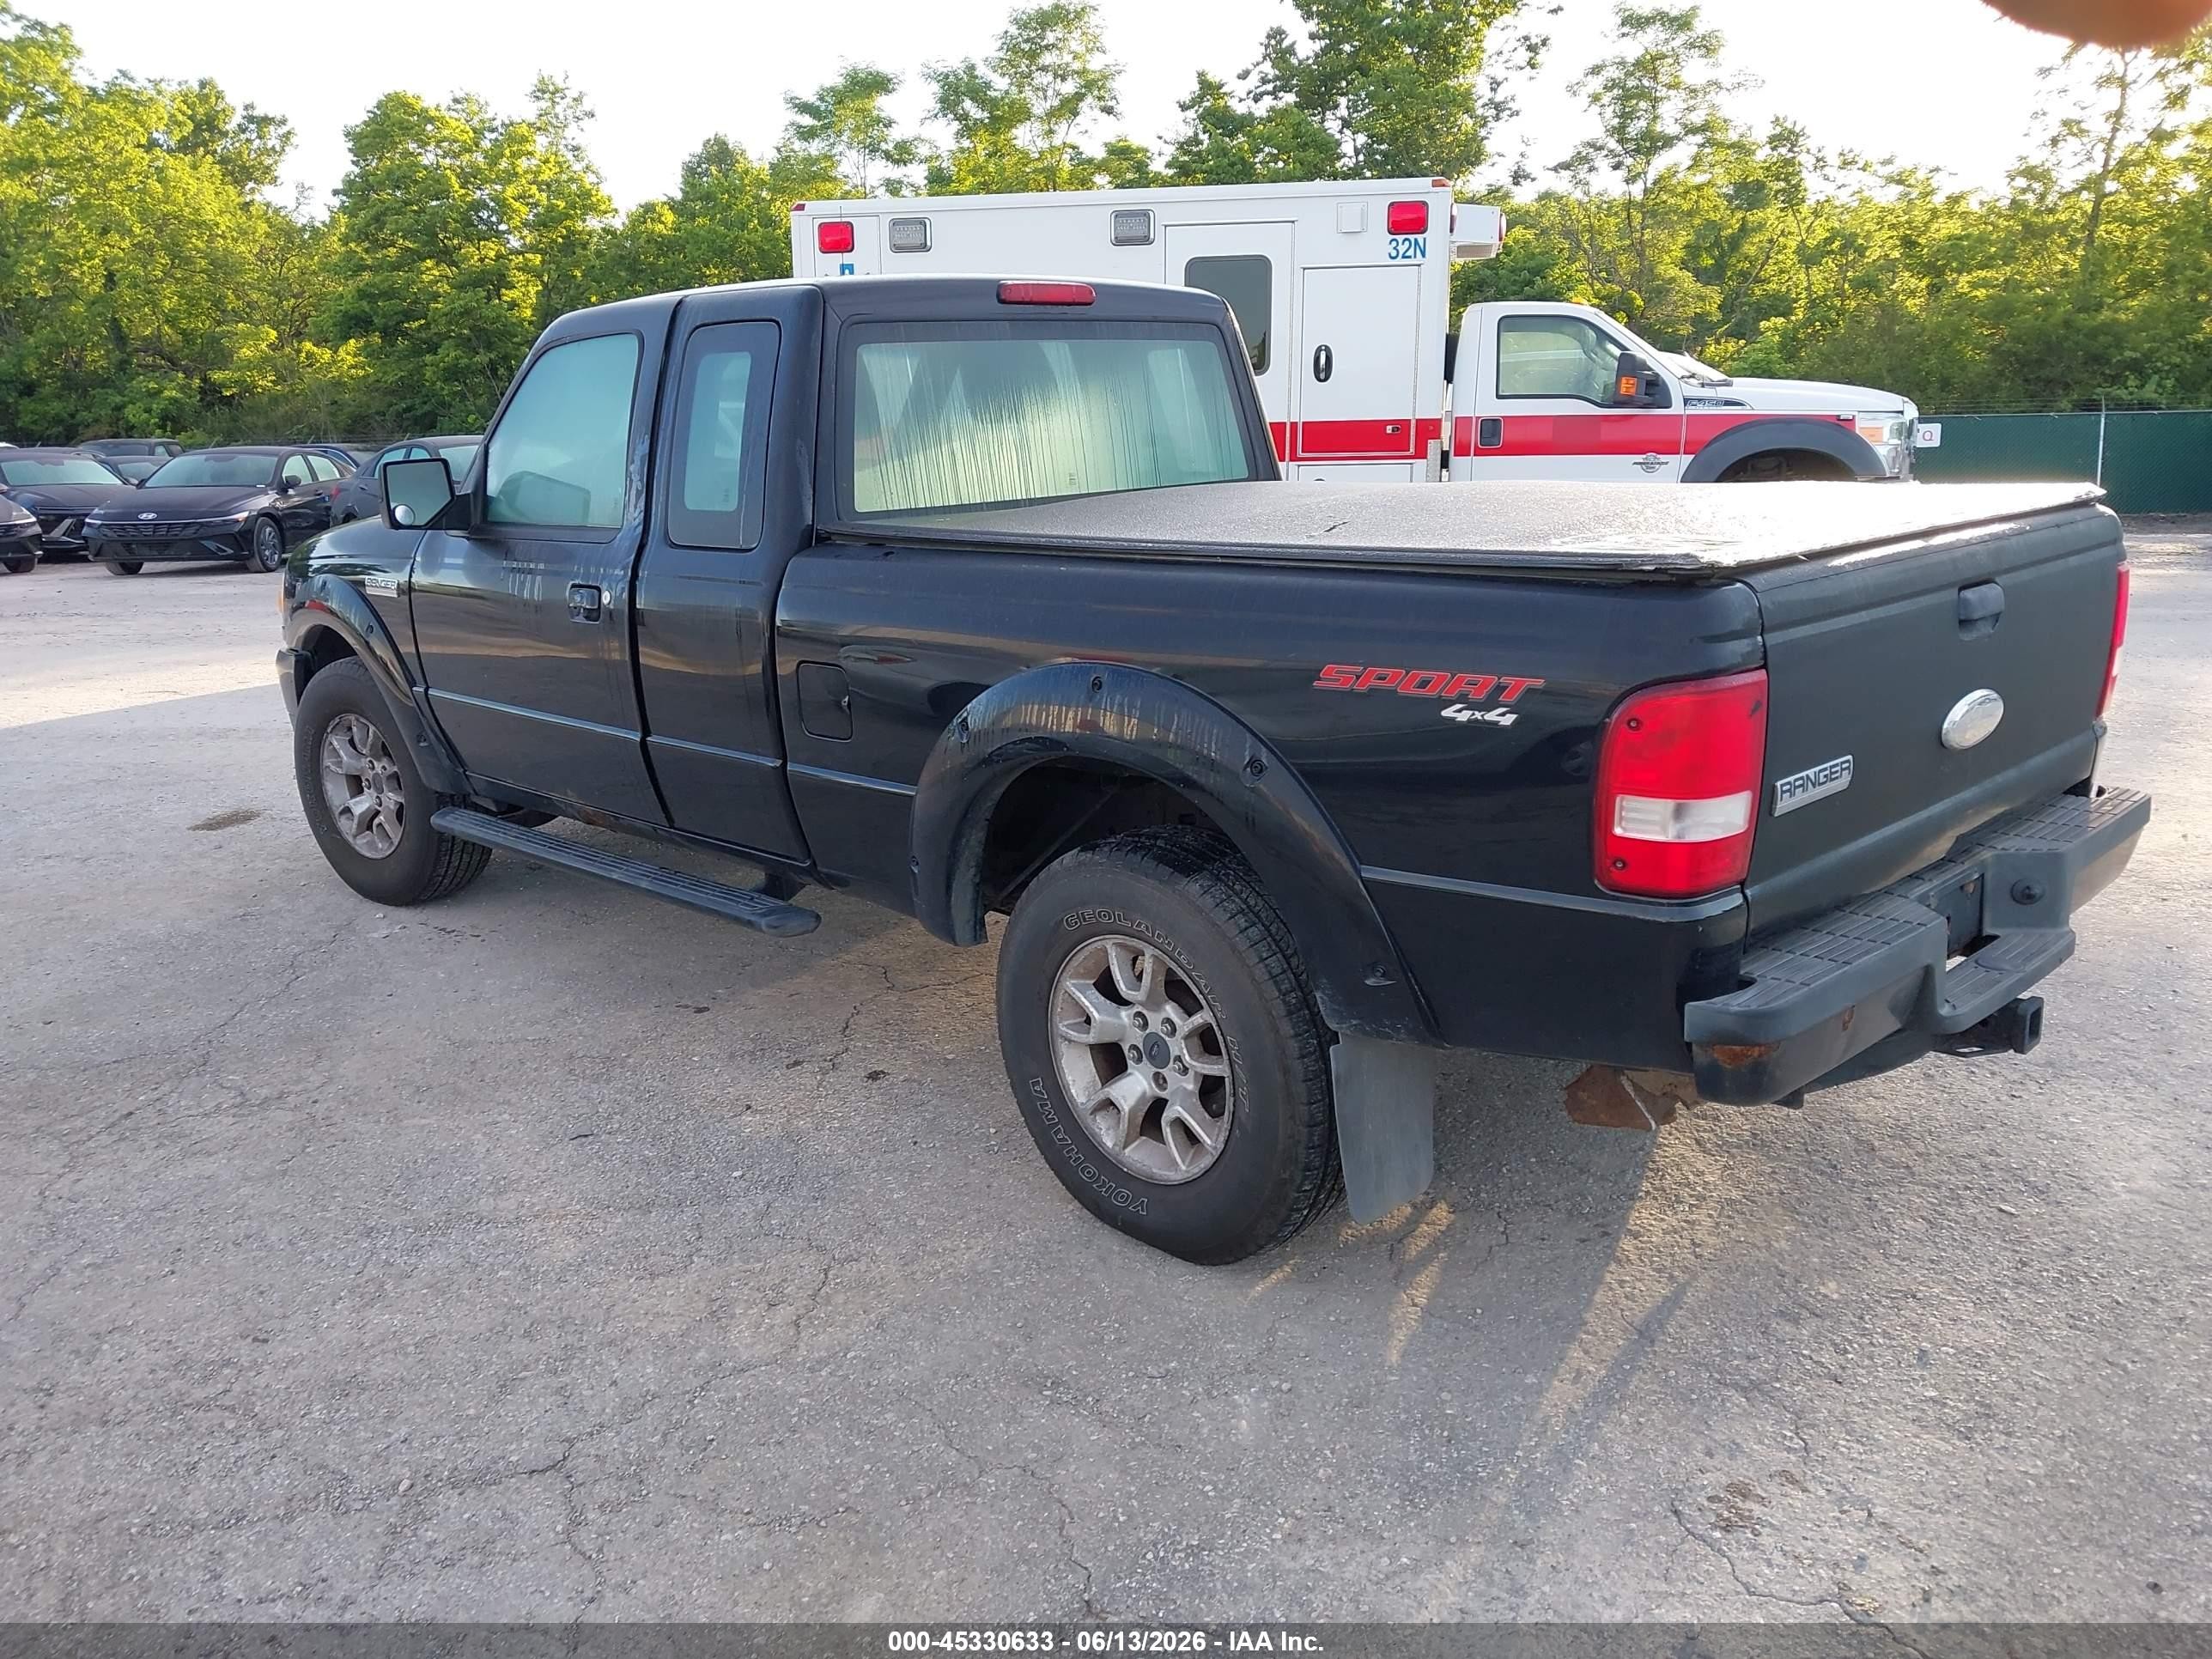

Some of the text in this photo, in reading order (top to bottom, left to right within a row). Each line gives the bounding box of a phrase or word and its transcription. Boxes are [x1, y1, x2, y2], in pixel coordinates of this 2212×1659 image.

[1388, 237, 1427, 260] 32N
[1313, 664, 1546, 703] SPORT
[1779, 759, 1851, 802] RANGER
[1063, 908, 1228, 1020] GEOLANDAR
[1029, 1078, 1148, 1216] YOKOHAMA
